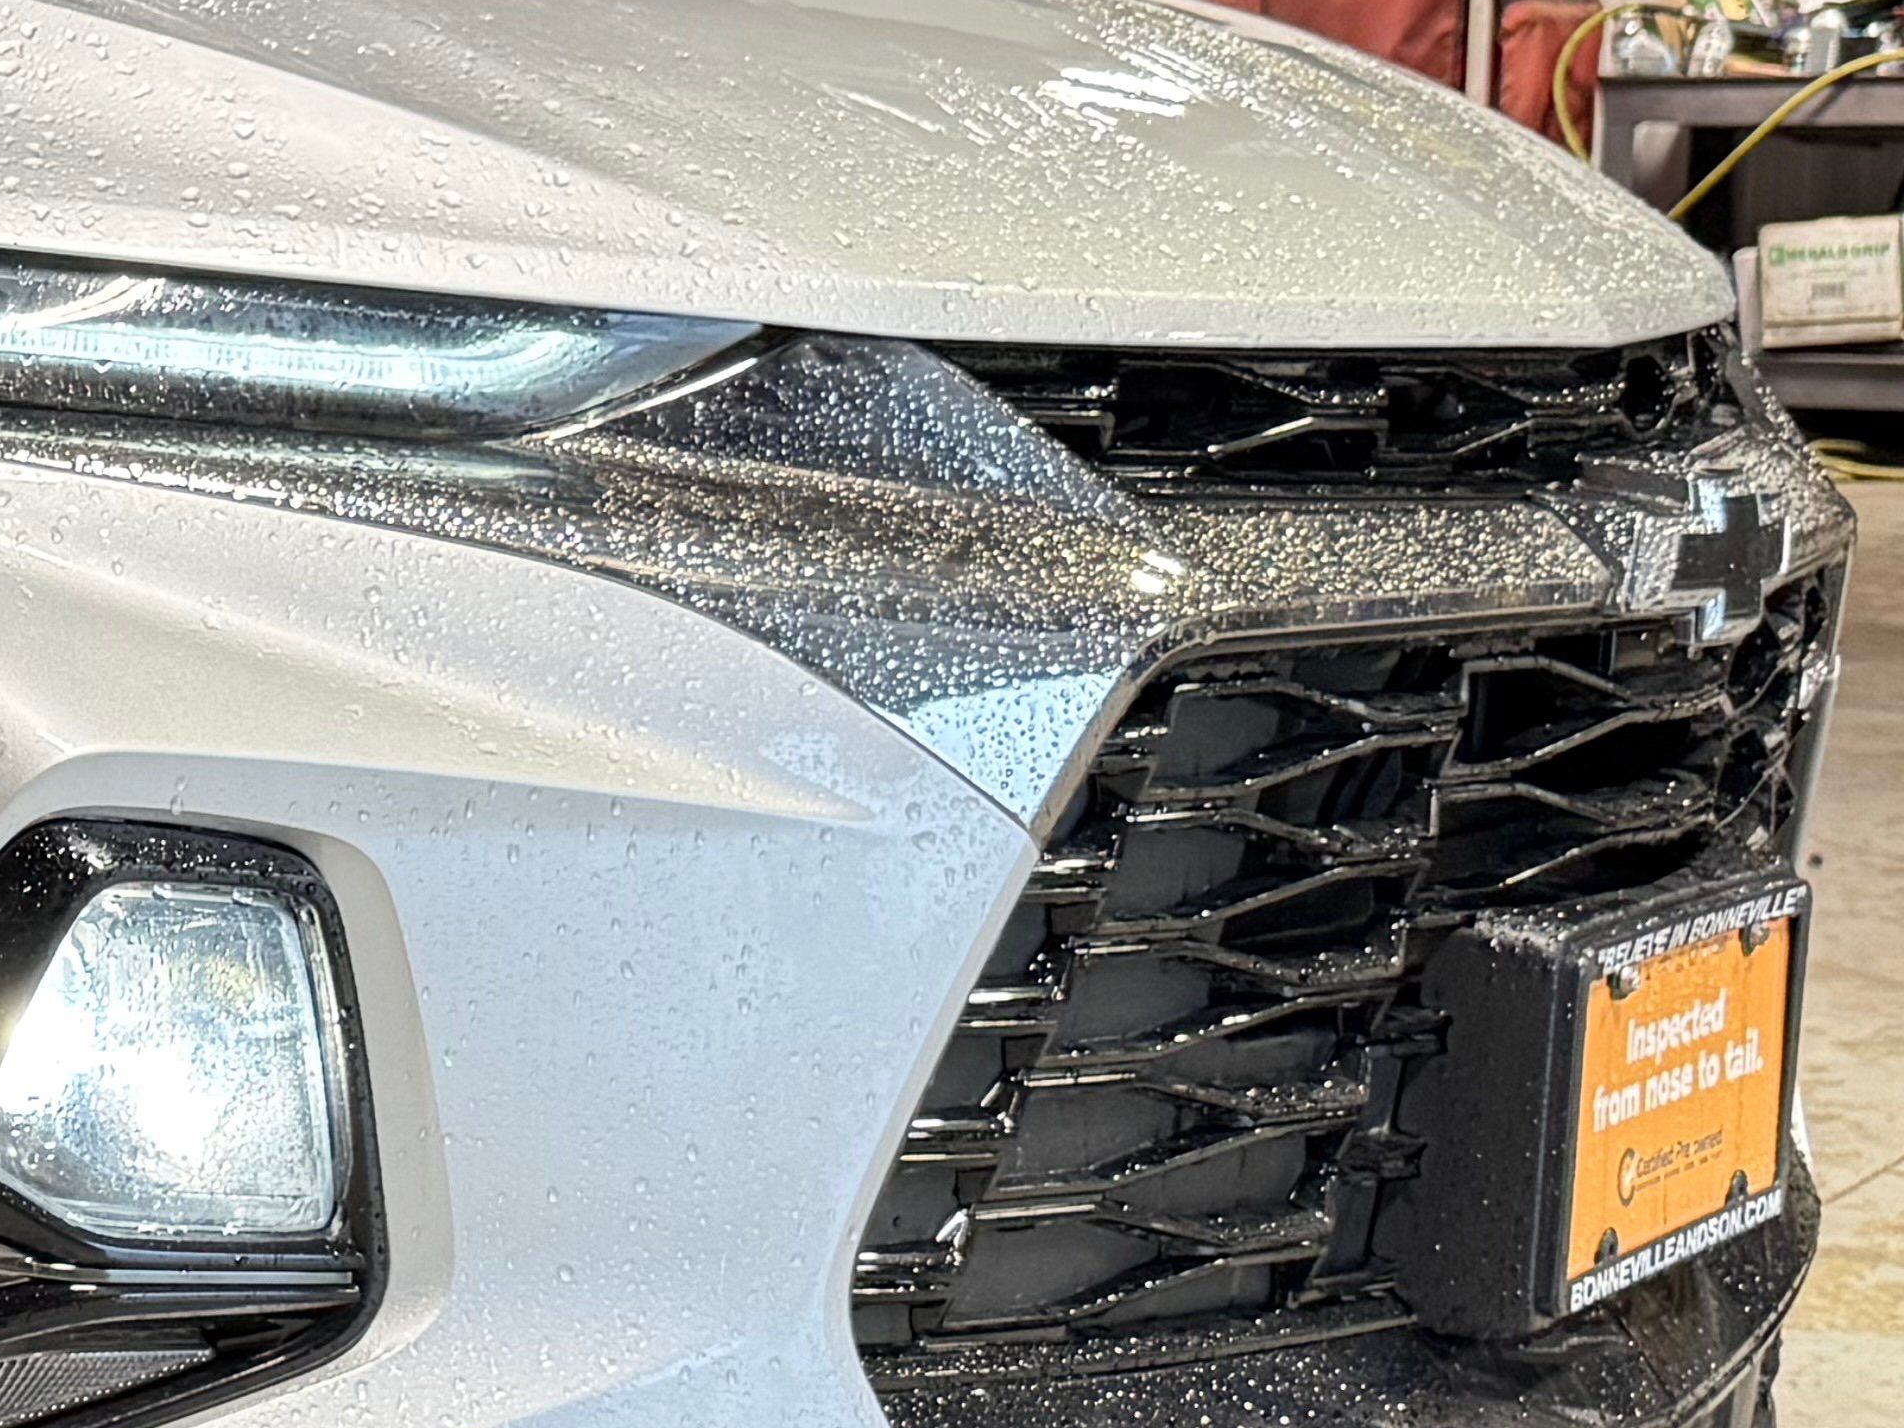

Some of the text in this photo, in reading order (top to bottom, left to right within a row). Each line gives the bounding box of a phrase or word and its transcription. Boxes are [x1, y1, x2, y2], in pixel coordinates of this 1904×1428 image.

[1669, 918, 1691, 947] IN
[1626, 988, 1729, 1066] Inspected
[1592, 1027, 1765, 1134] from nose to tail.
[1570, 1189, 1783, 1312] BONNEVILLEANDSON.COM
